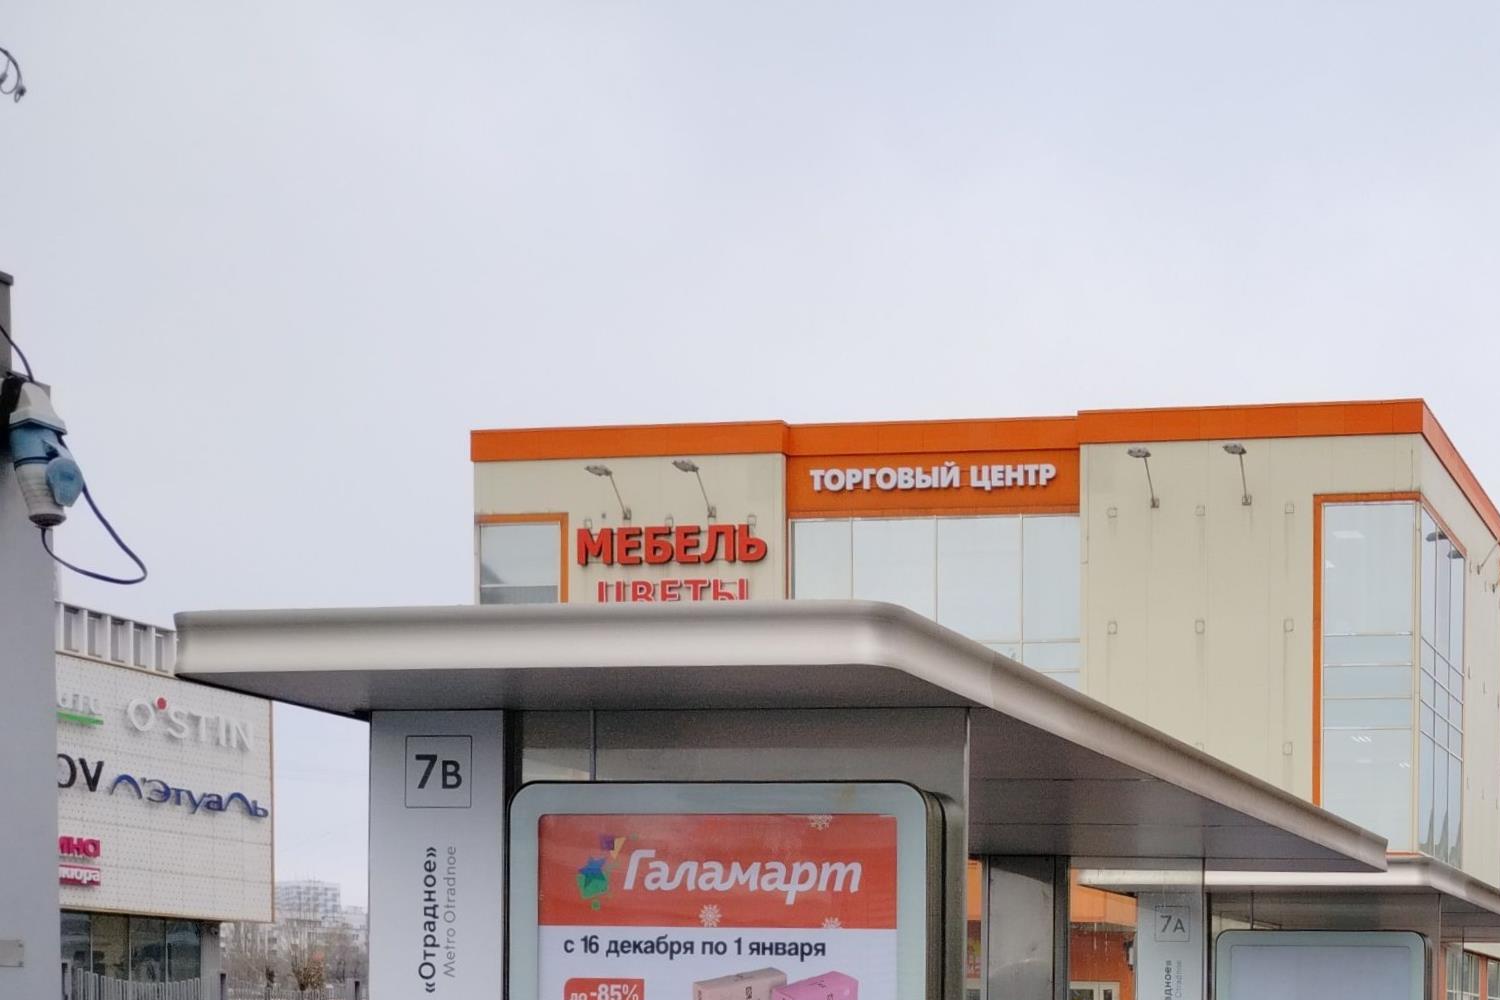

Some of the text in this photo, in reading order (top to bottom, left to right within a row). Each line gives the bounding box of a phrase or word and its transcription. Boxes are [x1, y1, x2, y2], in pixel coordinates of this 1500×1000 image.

[810, 461, 1056, 492] ТОРГОВЫЙ ЦЕНТР
[577, 524, 768, 566] МЕБЕЛЬ
[598, 578, 748, 602] ЦВЕТЫ
[415, 754, 463, 790] 7В
[623, 849, 862, 905] Галамарт
[418, 847, 440, 993] «Отрадное»
[443, 846, 456, 978] Metro Otradnoe
[1160, 915, 1185, 933] 7А
[564, 934, 826, 962] с 16 декабря по 1 января
